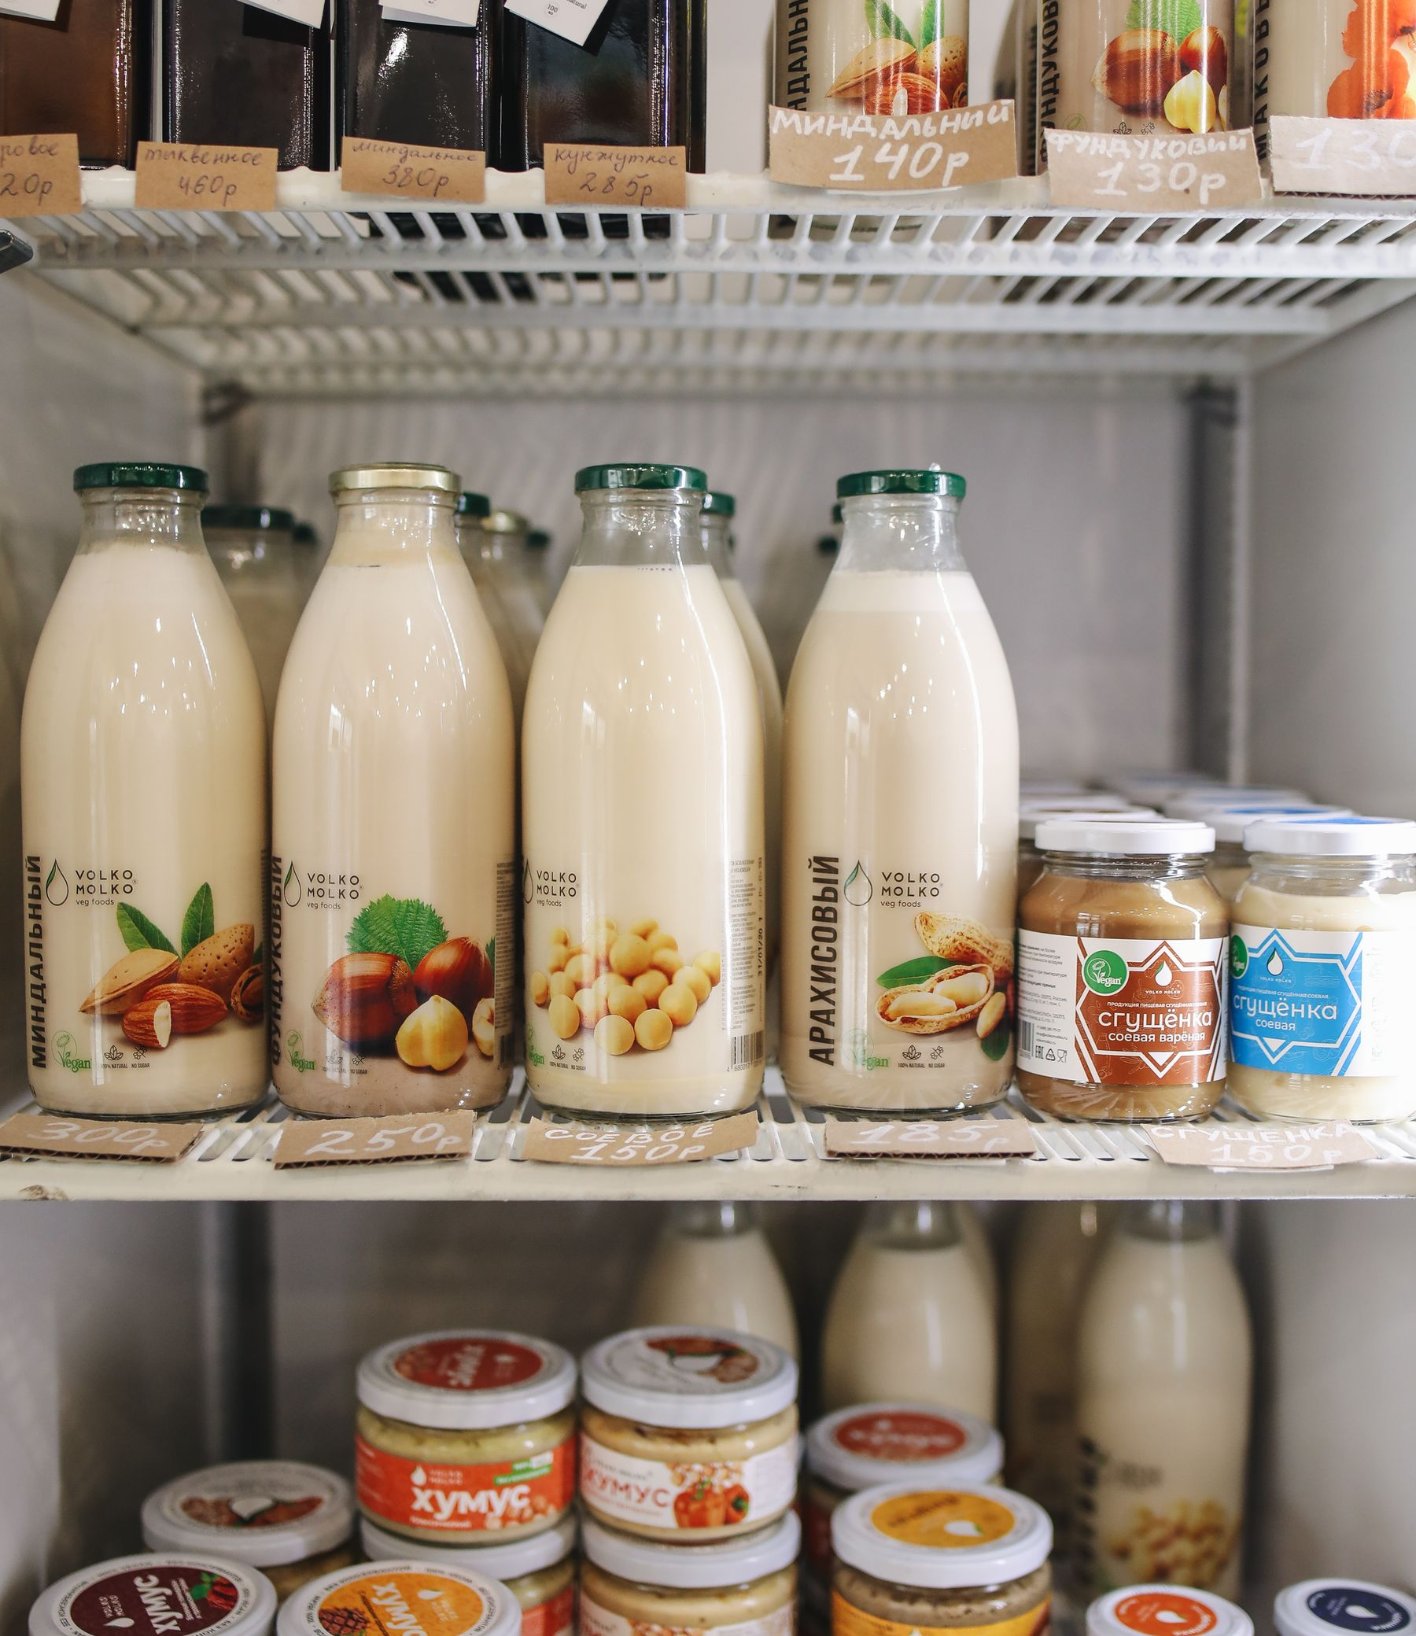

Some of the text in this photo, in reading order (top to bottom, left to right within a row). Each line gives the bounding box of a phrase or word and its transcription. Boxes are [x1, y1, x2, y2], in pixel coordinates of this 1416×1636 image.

[1040, 0, 1060, 163] УНДУКОВ
[772, 104, 1010, 140] МИНДАЛЬНЫЙ
[352, 140, 479, 162] миндальное
[554, 147, 679, 173] кунжутное
[829, 142, 970, 187] 140р
[179, 175, 238, 207] 460р
[382, 164, 450, 197] 380р
[579, 173, 653, 206] 285р
[1093, 161, 1227, 205] 130р
[75, 869, 133, 881] VOLKO
[307, 872, 360, 886] VOLKO
[536, 870, 577, 883] VOLKO
[881, 871, 941, 883] VOLKO
[75, 883, 133, 895] MOLKO
[307, 887, 360, 900] MOLKO
[536, 884, 577, 898] MOLKO
[881, 886, 940, 898] MOLKO
[75, 898, 115, 907] veg foods
[307, 901, 319, 910] veg
[898, 900, 921, 908] foods
[25, 855, 47, 1069] МИНДАЛЬНЫЙ
[808, 855, 839, 1067] АРАХИСОВЫЙ
[1233, 994, 1338, 1020] сгущёнка
[1098, 1008, 1212, 1033] сгущёнка
[1255, 1018, 1296, 1031] соевая
[1108, 1031, 1206, 1044] соевая варёная
[58, 1051, 92, 1073] Vegan
[289, 1055, 315, 1073] Vegan
[26, 1122, 170, 1153] 300р
[304, 1122, 462, 1156] 250р
[544, 1123, 714, 1144] СОЕВОЕ
[133, 1573, 184, 1635] хумус
